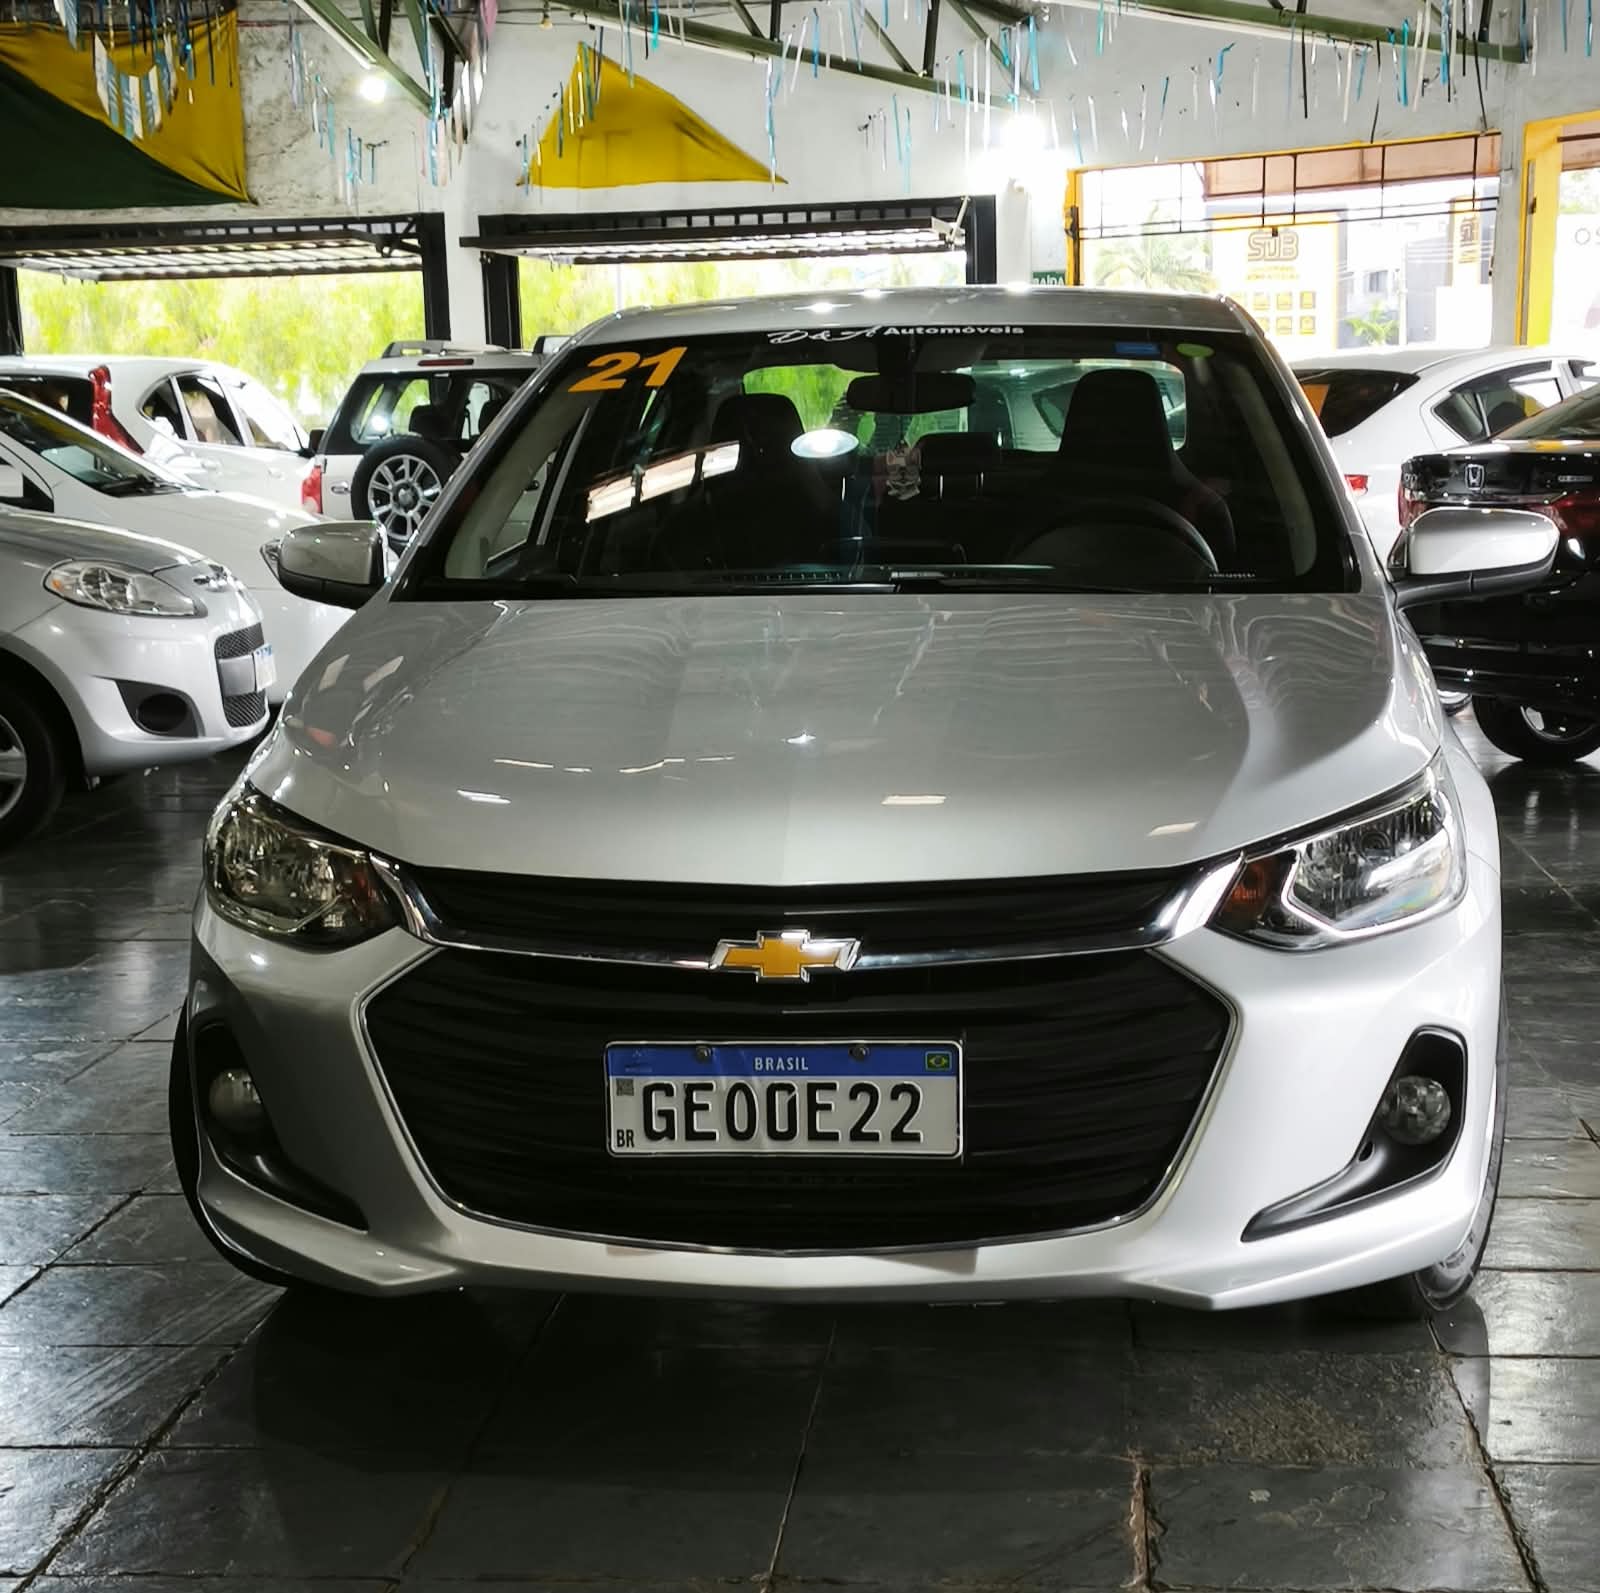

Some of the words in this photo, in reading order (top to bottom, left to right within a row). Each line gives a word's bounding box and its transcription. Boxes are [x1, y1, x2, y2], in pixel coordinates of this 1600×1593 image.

[884, 325, 1025, 336] Automóveis
[568, 346, 688, 393] 21
[754, 1056, 809, 1071] BRASIL
[616, 1129, 635, 1148] BR
